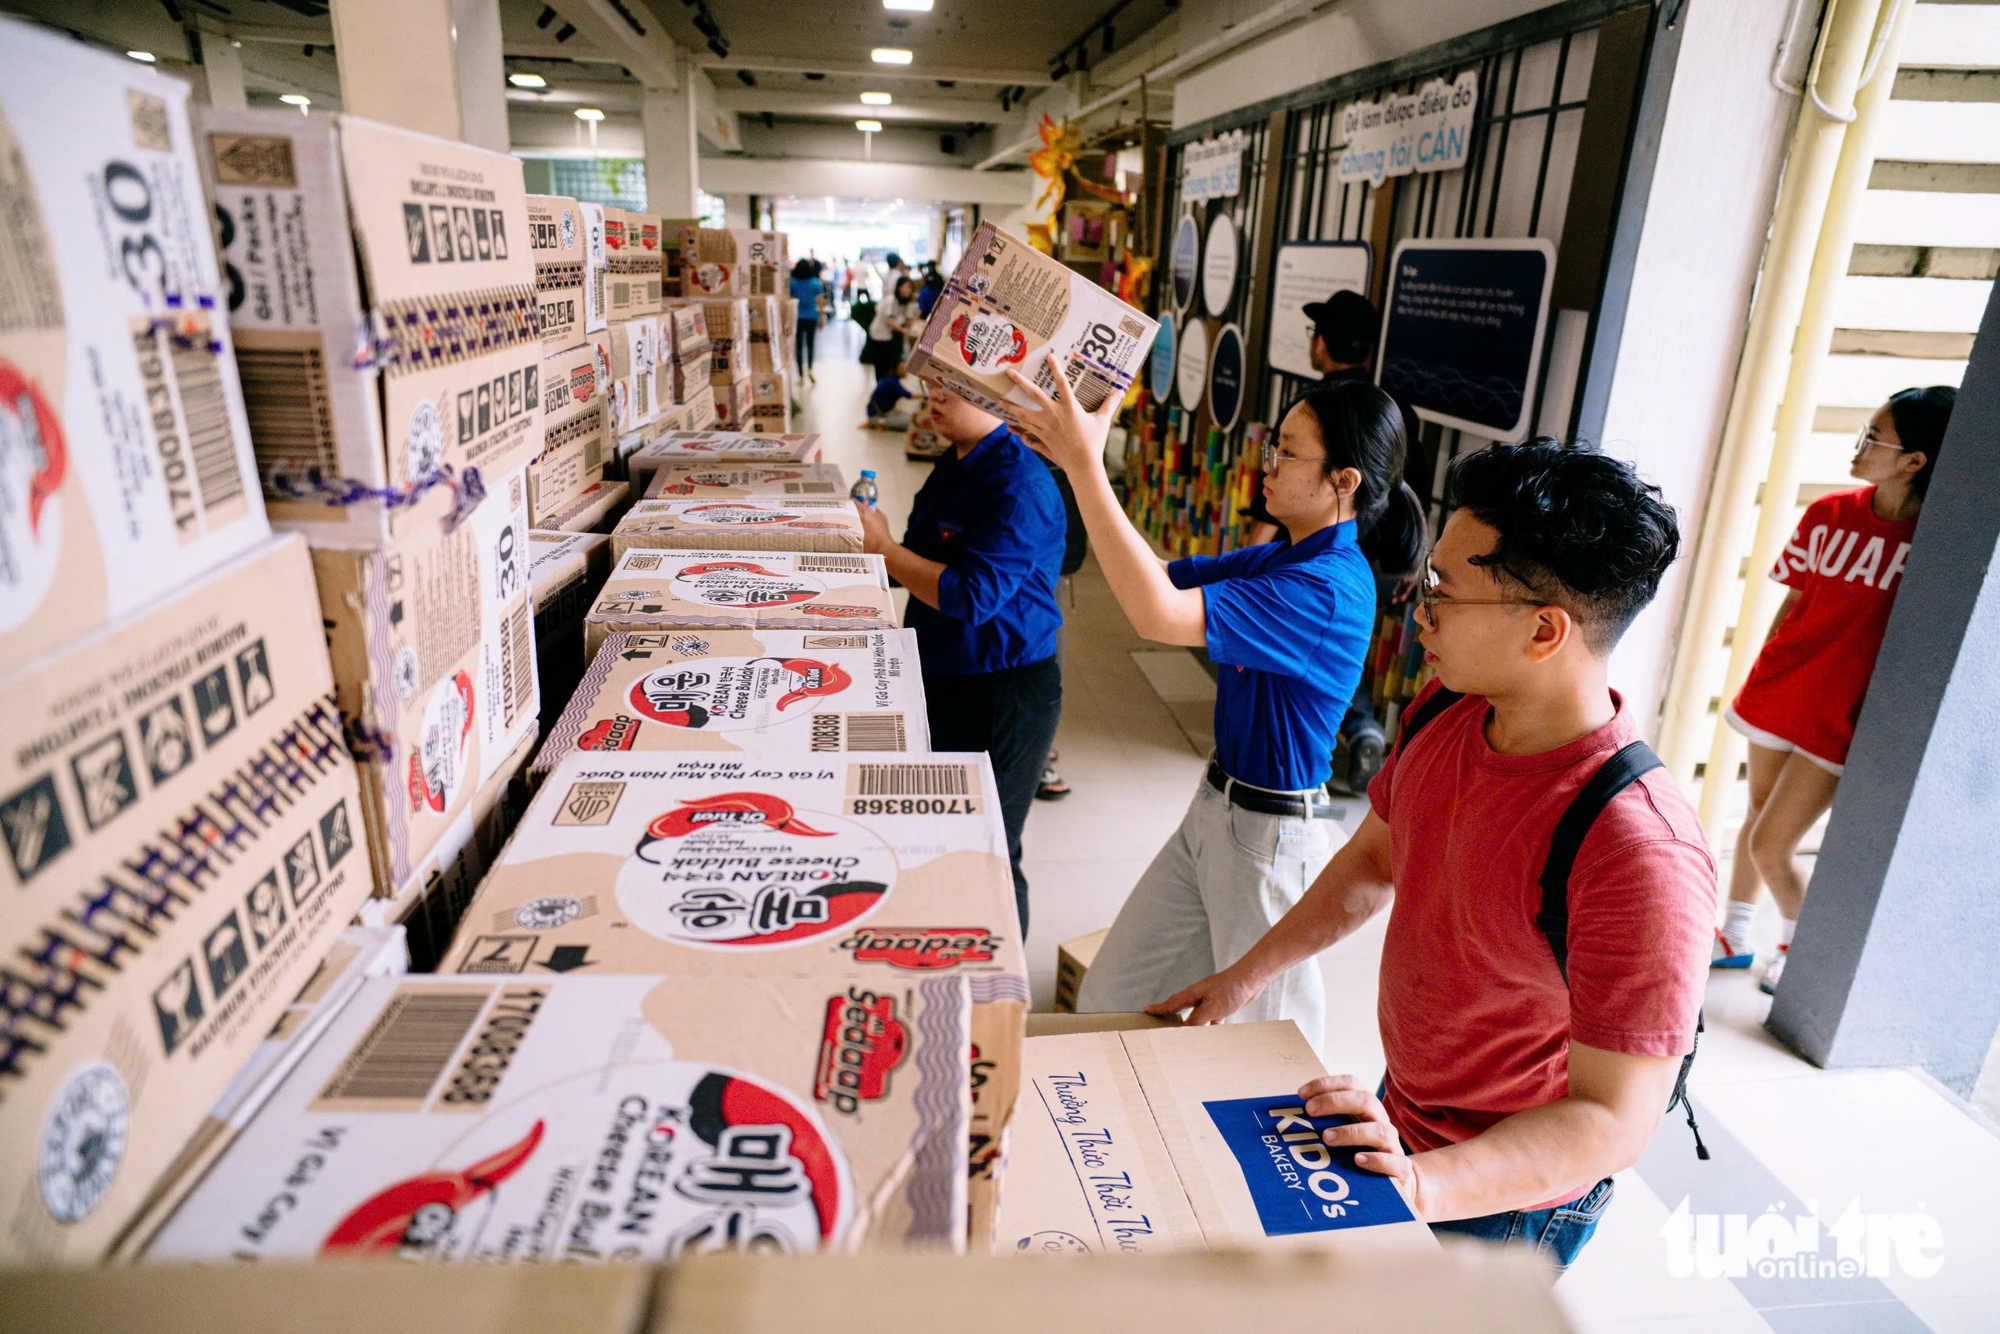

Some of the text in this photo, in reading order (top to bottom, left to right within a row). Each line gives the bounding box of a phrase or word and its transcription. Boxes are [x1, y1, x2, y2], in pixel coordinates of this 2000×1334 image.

[105, 158, 168, 296] 30
[751, 242, 765, 261] 30
[1076, 321, 1093, 346] Content
[1083, 323, 1116, 363] 30
[1112, 334, 1125, 354] Packs
[568, 371, 597, 388] Sedaap
[499, 524, 515, 599] 30
[798, 566, 870, 574] 17008368
[501, 615, 515, 731] 17008368
[648, 671, 710, 711] 매운
[870, 634, 893, 708] Vị Gà Cay Phô Mai Hàn Quốc
[709, 684, 731, 716] KOREAN
[729, 666, 755, 719] Cheese Buldak
[811, 714, 840, 752] 7008368
[576, 770, 835, 782] Vị Gà Cay Phô Mai Hàn Quốc
[677, 761, 743, 770] Mì trộn
[853, 799, 976, 815] 17008368
[670, 856, 859, 867] Cheese Buldak
[731, 870, 850, 881] KOREAN
[669, 887, 828, 934] 매운
[481, 940, 511, 961] 7
[839, 933, 1004, 956] Sedaap
[443, 989, 546, 1104] 17008368
[826, 986, 878, 1116] Sedaap
[1047, 1071, 1089, 1126] Thưởng
[588, 1094, 650, 1192] Cheese
[1070, 1127, 1113, 1169] Thức
[1260, 1133, 1306, 1192] BAKERY
[1267, 1105, 1361, 1219] KIDO's
[618, 1104, 677, 1236] KOREAN
[1088, 1170, 1135, 1212] Thời
